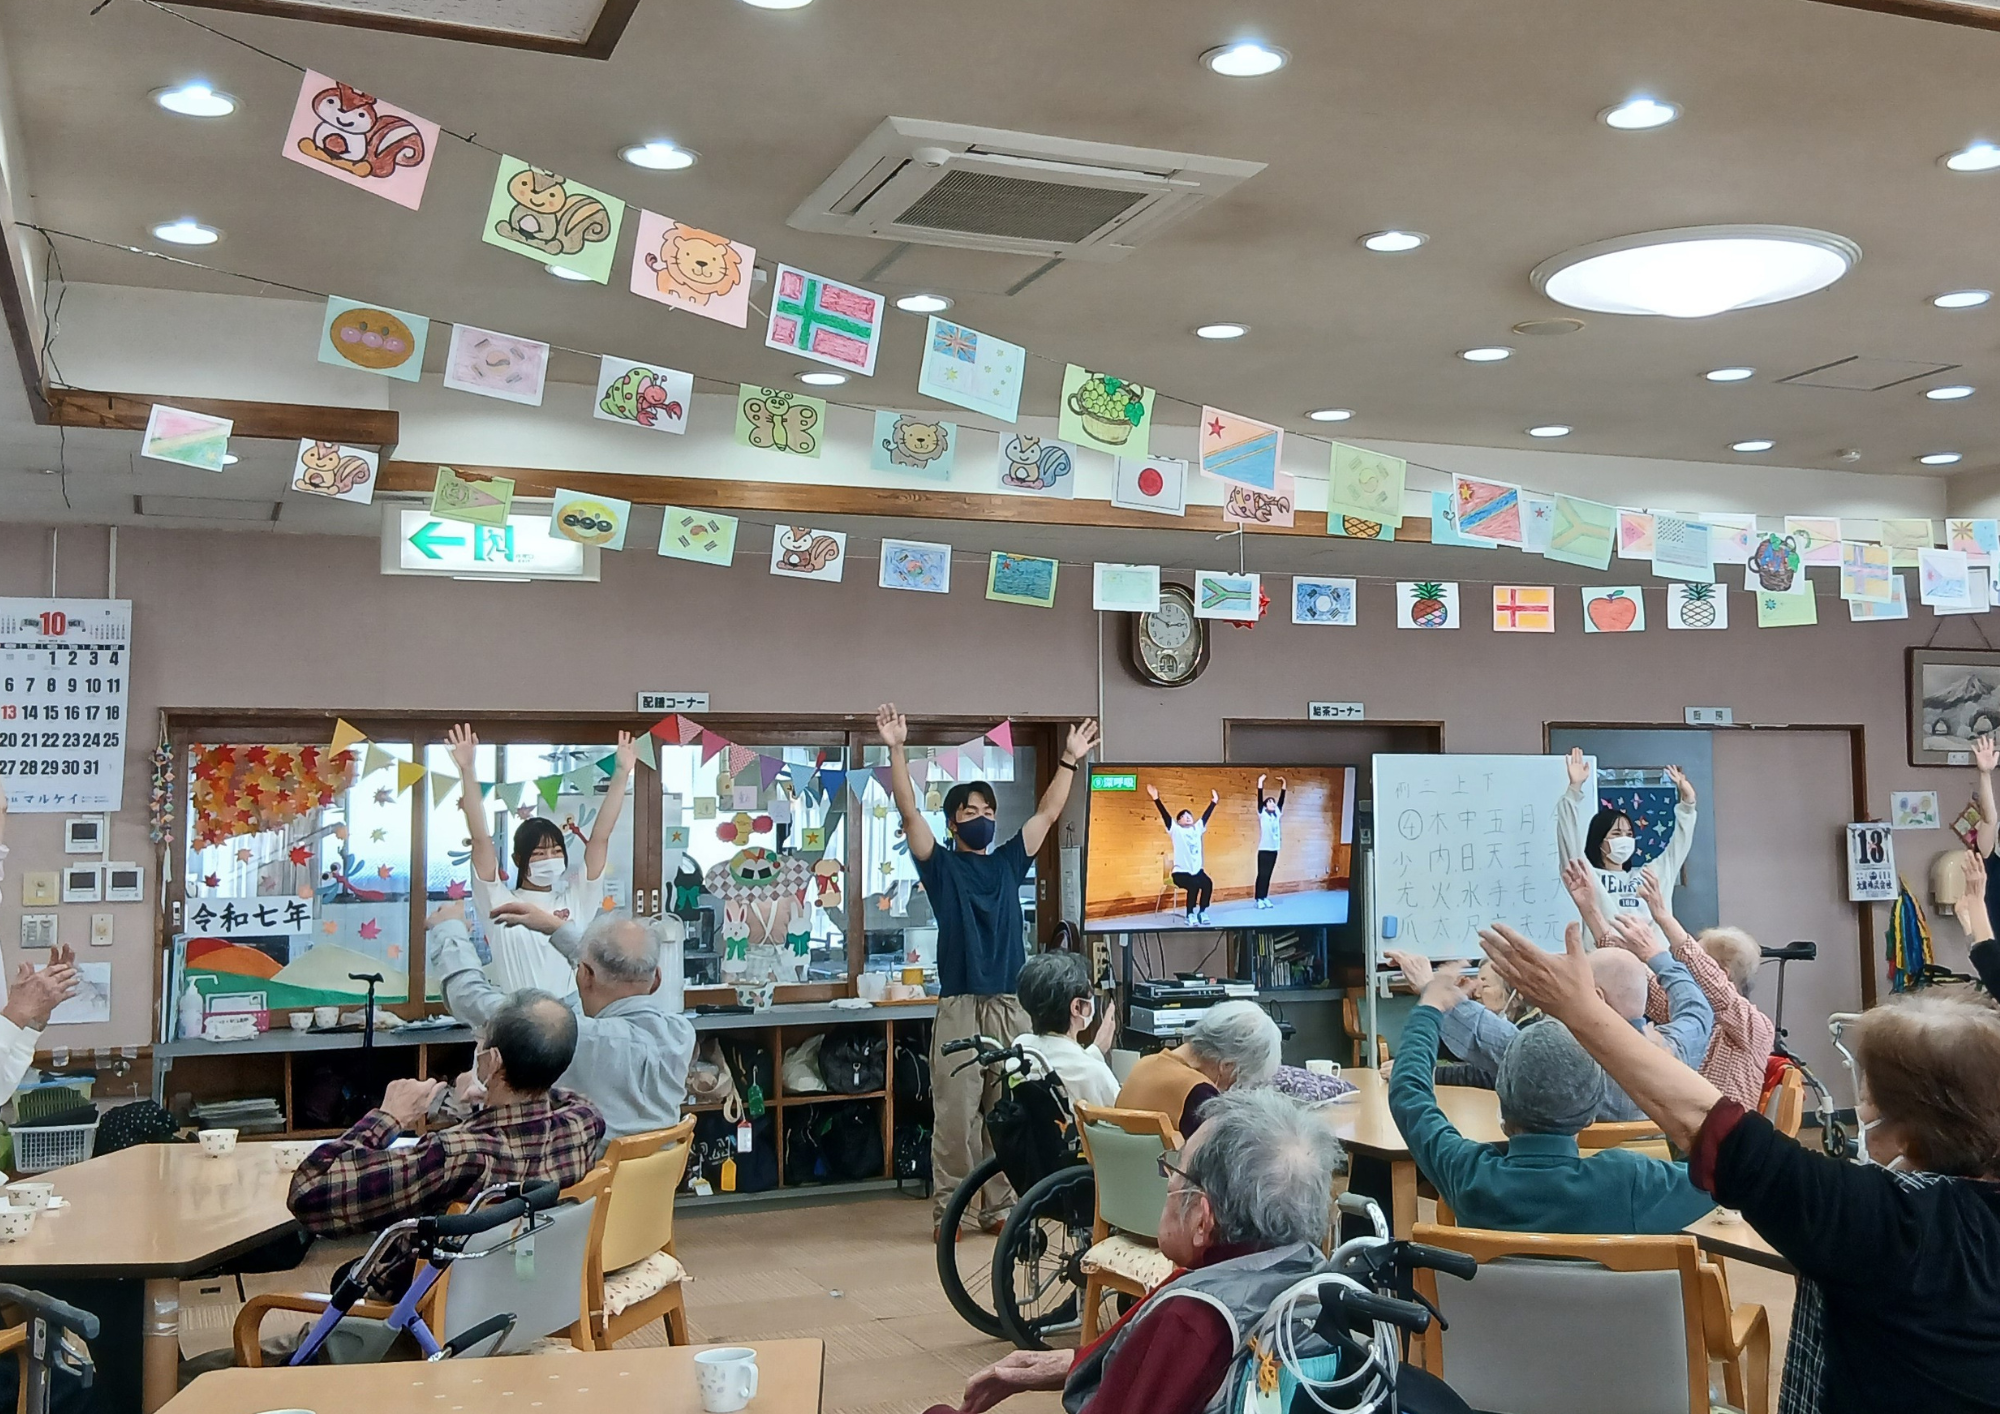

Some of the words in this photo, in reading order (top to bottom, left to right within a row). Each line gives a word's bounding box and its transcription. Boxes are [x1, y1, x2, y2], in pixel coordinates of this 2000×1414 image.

[40, 612, 66, 636] 10
[49, 651, 55, 665] 1
[68, 651, 78, 665] 2
[89, 652, 98, 665] 3
[109, 652, 119, 666] 4
[5, 678, 14, 692] 6
[26, 678, 35, 692] 7
[47, 678, 56, 692] 8
[68, 678, 77, 693] 9
[85, 678, 101, 693] 10
[107, 679, 120, 693] 11
[1, 705, 17, 719] 13
[22, 705, 38, 720] 14
[43, 705, 59, 720] 15
[64, 705, 79, 720] 16
[85, 706, 100, 720] 17
[105, 705, 119, 720] 18
[0, 733, 17, 747] 20
[21, 733, 38, 747] 21
[41, 733, 59, 747] 22
[62, 733, 80, 747] 23
[83, 733, 100, 747] 24
[103, 733, 119, 747] 25
[0, 760, 16, 775] 27
[20, 760, 38, 775] 28
[41, 760, 58, 775] 29
[62, 760, 79, 775] 30
[83, 760, 99, 775] 31
[191, 900, 311, 932] 令和七年
